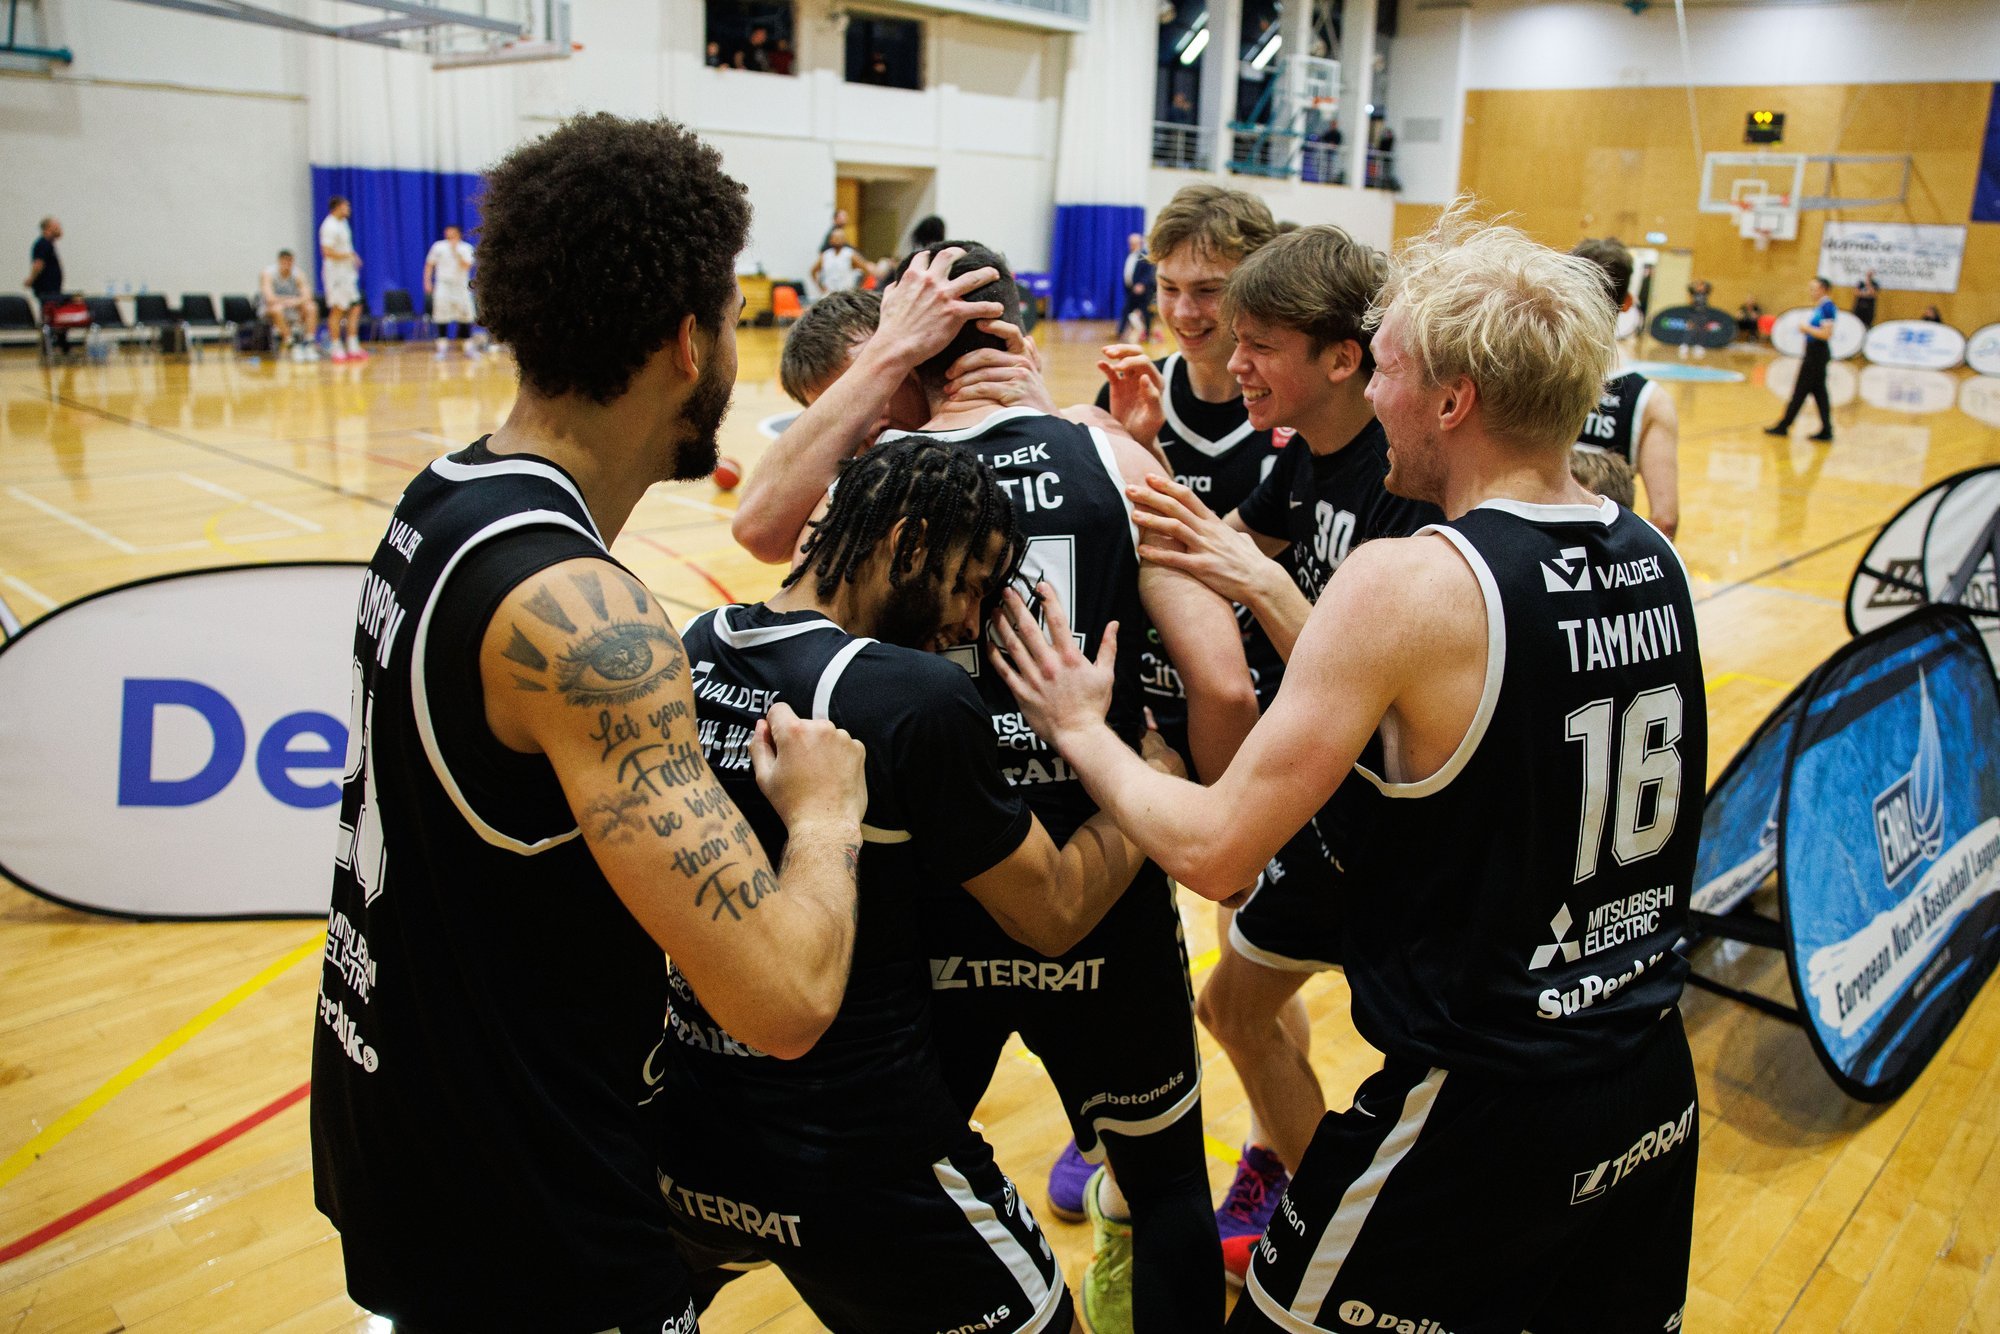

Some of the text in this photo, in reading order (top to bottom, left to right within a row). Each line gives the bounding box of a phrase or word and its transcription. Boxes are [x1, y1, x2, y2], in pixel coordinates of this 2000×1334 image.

[1314, 500, 1356, 571] 30
[1595, 555, 1664, 590] VALDEK
[1557, 603, 1682, 673] TAMKIVI
[699, 680, 781, 714] VALDEK
[117, 677, 349, 810] De
[589, 709, 641, 762] Let
[617, 741, 705, 797] Faith
[1564, 682, 1683, 885] 16
[648, 810, 683, 838] be
[670, 836, 729, 878] than
[1586, 885, 1674, 933] MITSUBISHI
[1584, 911, 1660, 956] ELECTRIC
[1836, 944, 1892, 1020] European
[1891, 904, 1924, 962] North
[1922, 852, 1973, 928] Basketball
[966, 957, 1105, 992] TERRAT
[1107, 1071, 1184, 1105] betoneks
[1611, 1100, 1695, 1188] TERRAT
[676, 1185, 802, 1248] TERRAT
[936, 1304, 1011, 1334] oneks
[1376, 1313, 1456, 1334] Dail
